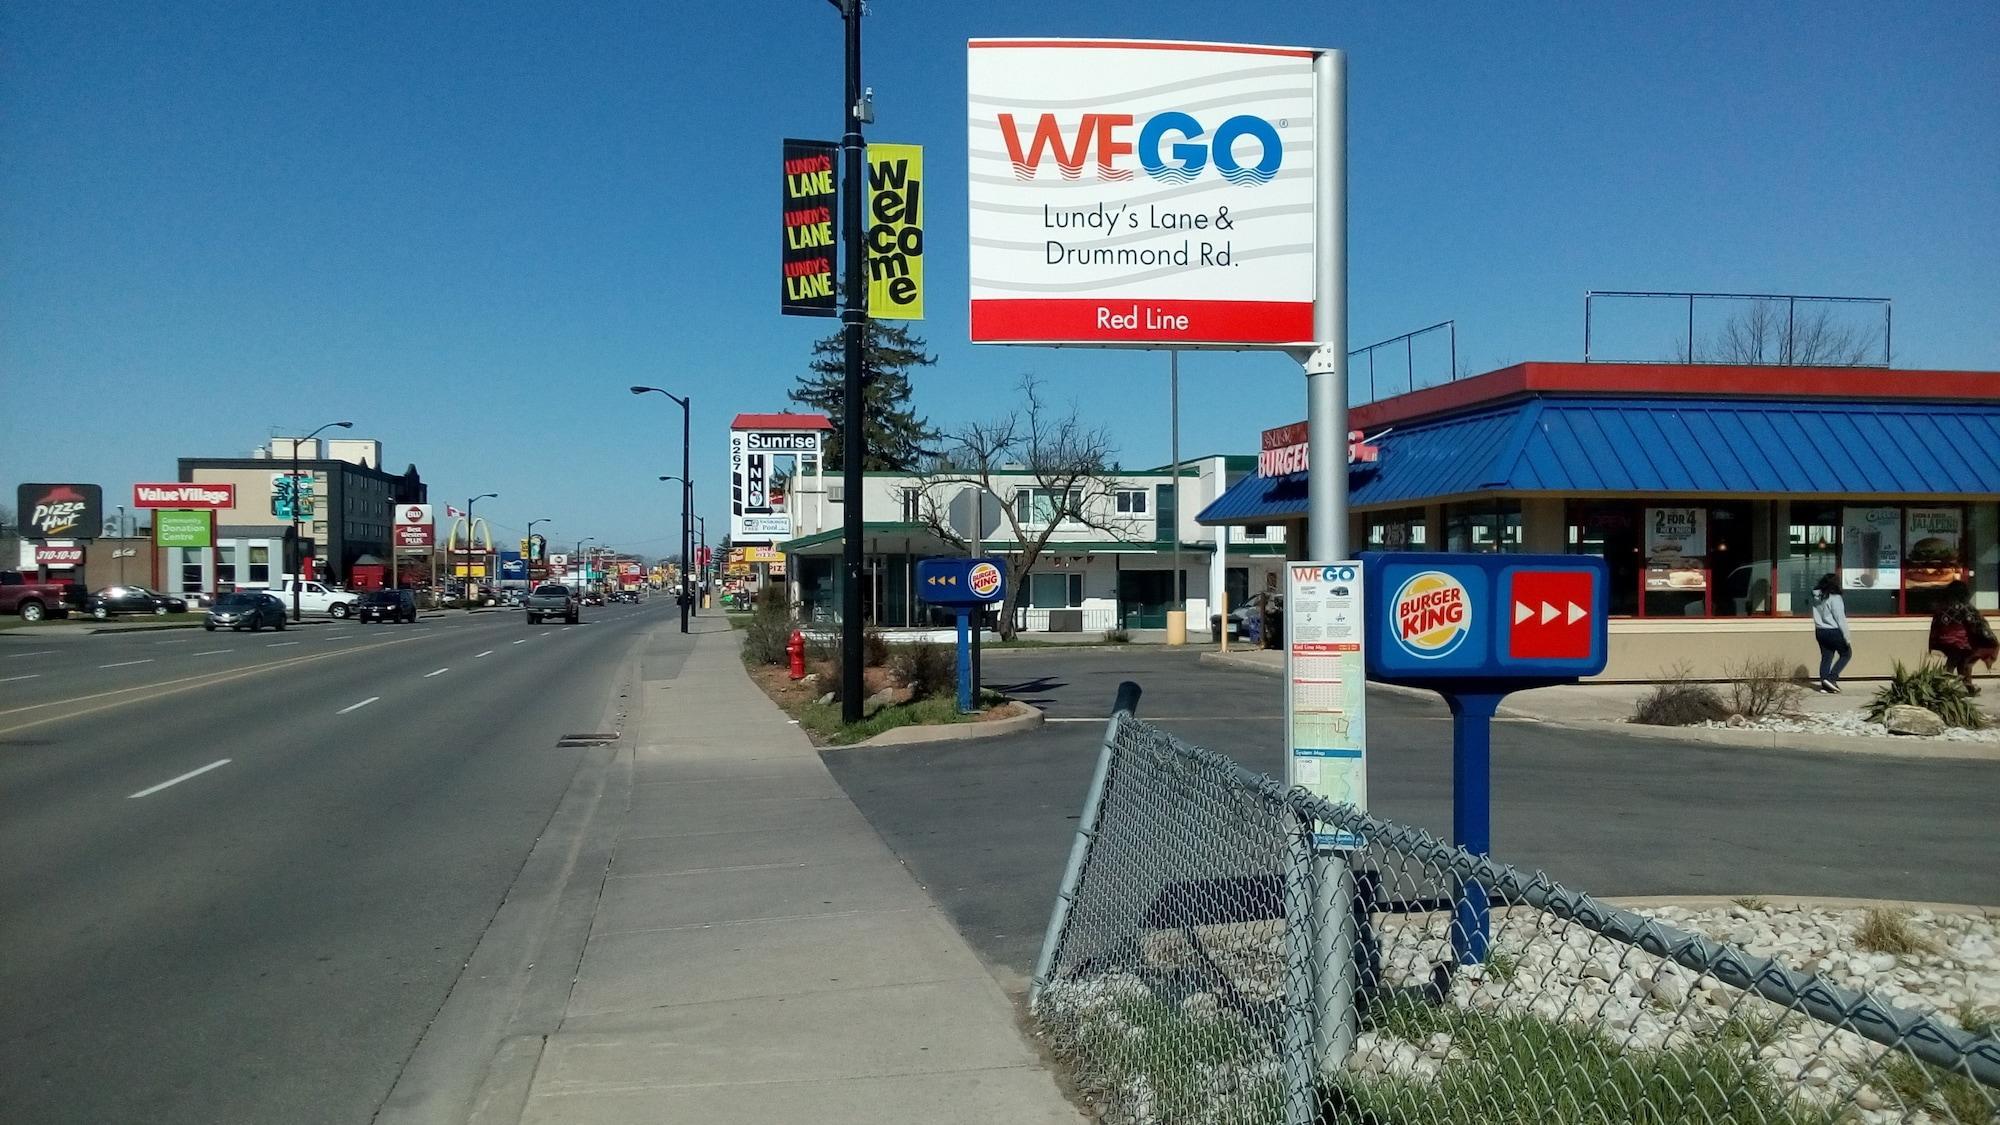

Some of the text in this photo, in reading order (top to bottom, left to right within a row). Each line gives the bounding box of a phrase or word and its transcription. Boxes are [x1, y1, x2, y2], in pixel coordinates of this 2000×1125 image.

[997, 111, 1283, 188] WEGO
[785, 154, 831, 175] LUNDY'S
[788, 170, 836, 198] LANE
[784, 206, 830, 226] LUNDY'S
[1044, 202, 1234, 235] Lundy's Lane &
[787, 221, 835, 250] LANE
[868, 159, 923, 305] welcome
[1046, 240, 1239, 267] Drummond Rd.
[784, 257, 830, 277] LUNDY'S
[787, 273, 835, 301] LANE
[1096, 305, 1190, 330] Red Line
[748, 433, 815, 448] Sunrise
[732, 437, 741, 471] 6267
[750, 454, 762, 491] INN
[137, 488, 229, 504] Value Village
[31, 501, 86, 525] Pizza
[41, 512, 80, 532] Hut
[1655, 509, 1665, 527] 2
[1667, 514, 1685, 525] FOR
[162, 524, 205, 532] Donation
[972, 570, 997, 582] BURGER
[974, 575, 998, 590] KING
[1292, 565, 1355, 581] WEGO
[1400, 588, 1460, 618] BURGER
[1403, 602, 1463, 640] KING
